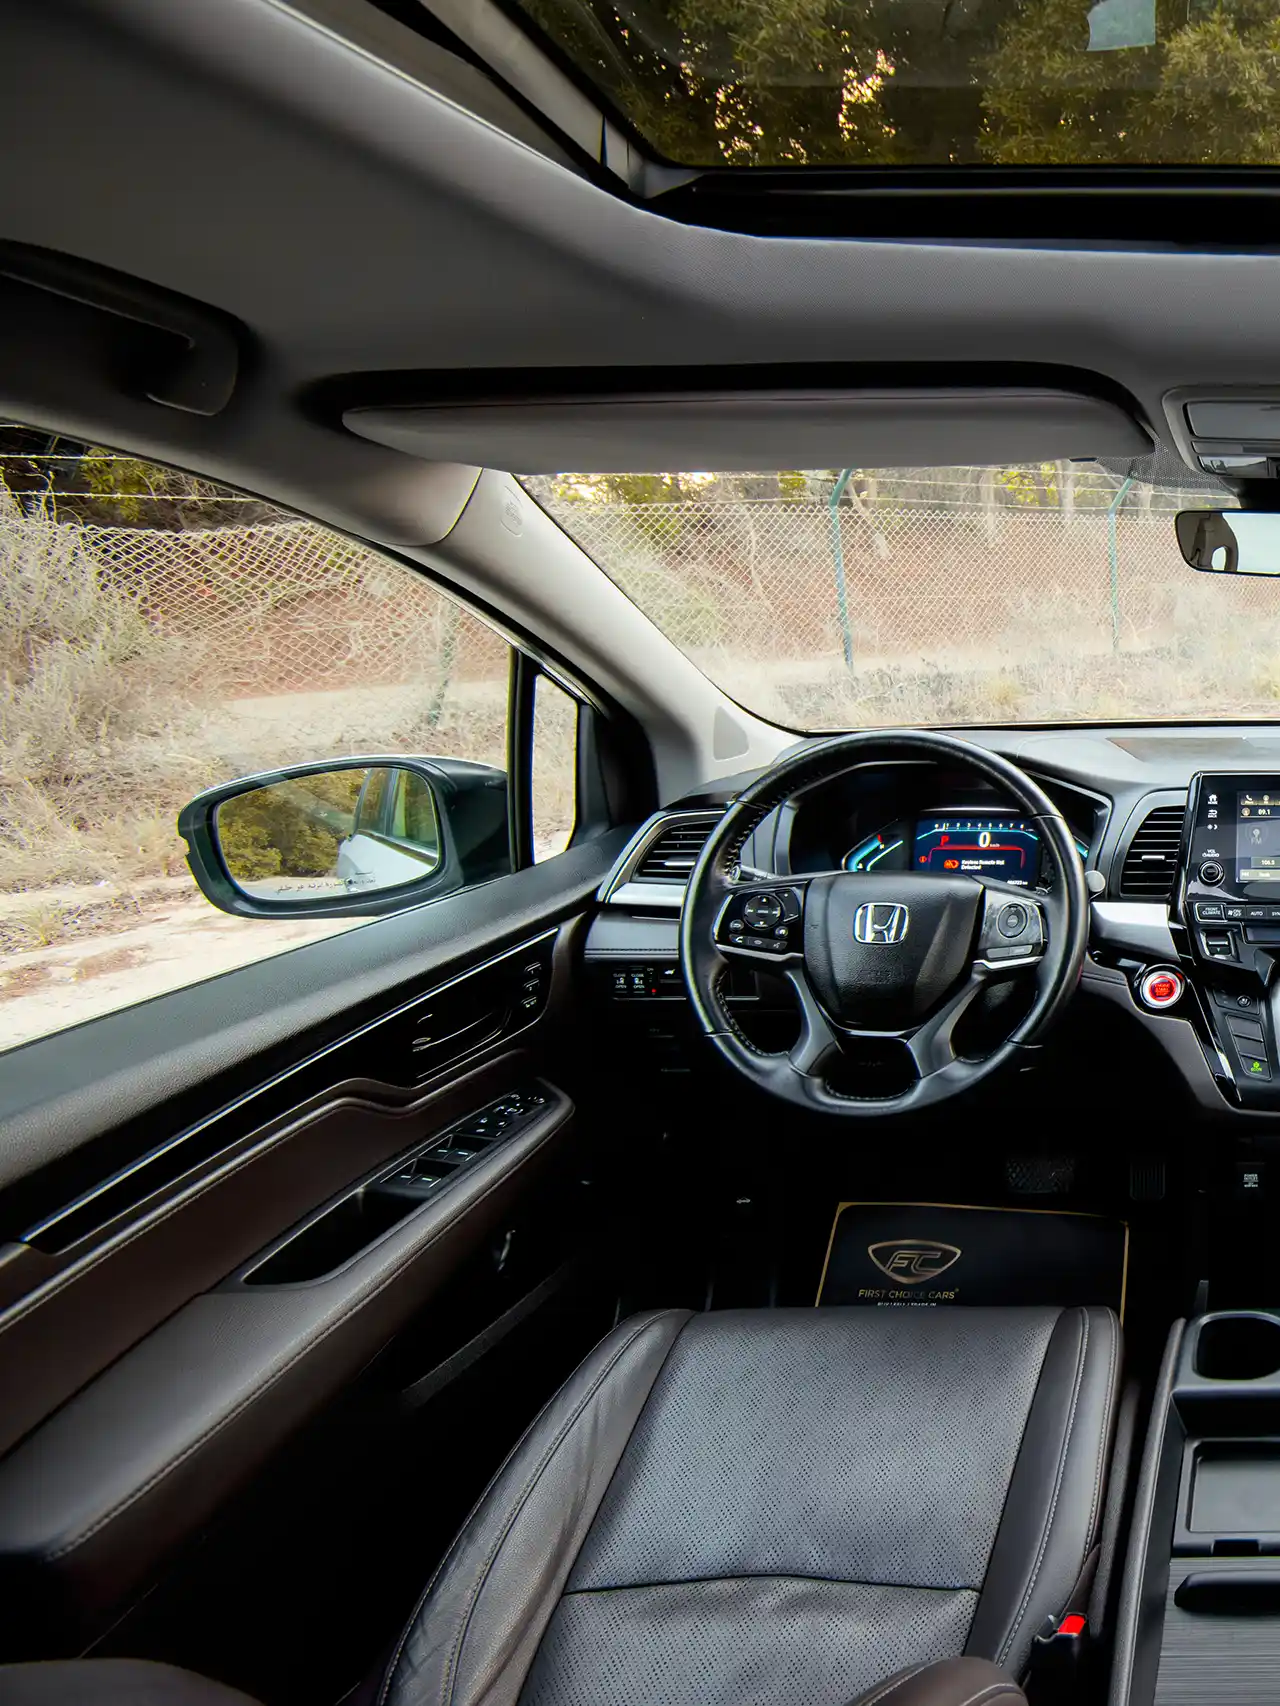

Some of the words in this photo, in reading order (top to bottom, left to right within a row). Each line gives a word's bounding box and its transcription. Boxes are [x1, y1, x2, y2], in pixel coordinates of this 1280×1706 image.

[940, 835, 950, 847] P
[978, 831, 991, 848] 0
[858, 1289, 887, 1299] FIRST
[928, 1290, 955, 1299] CARS
